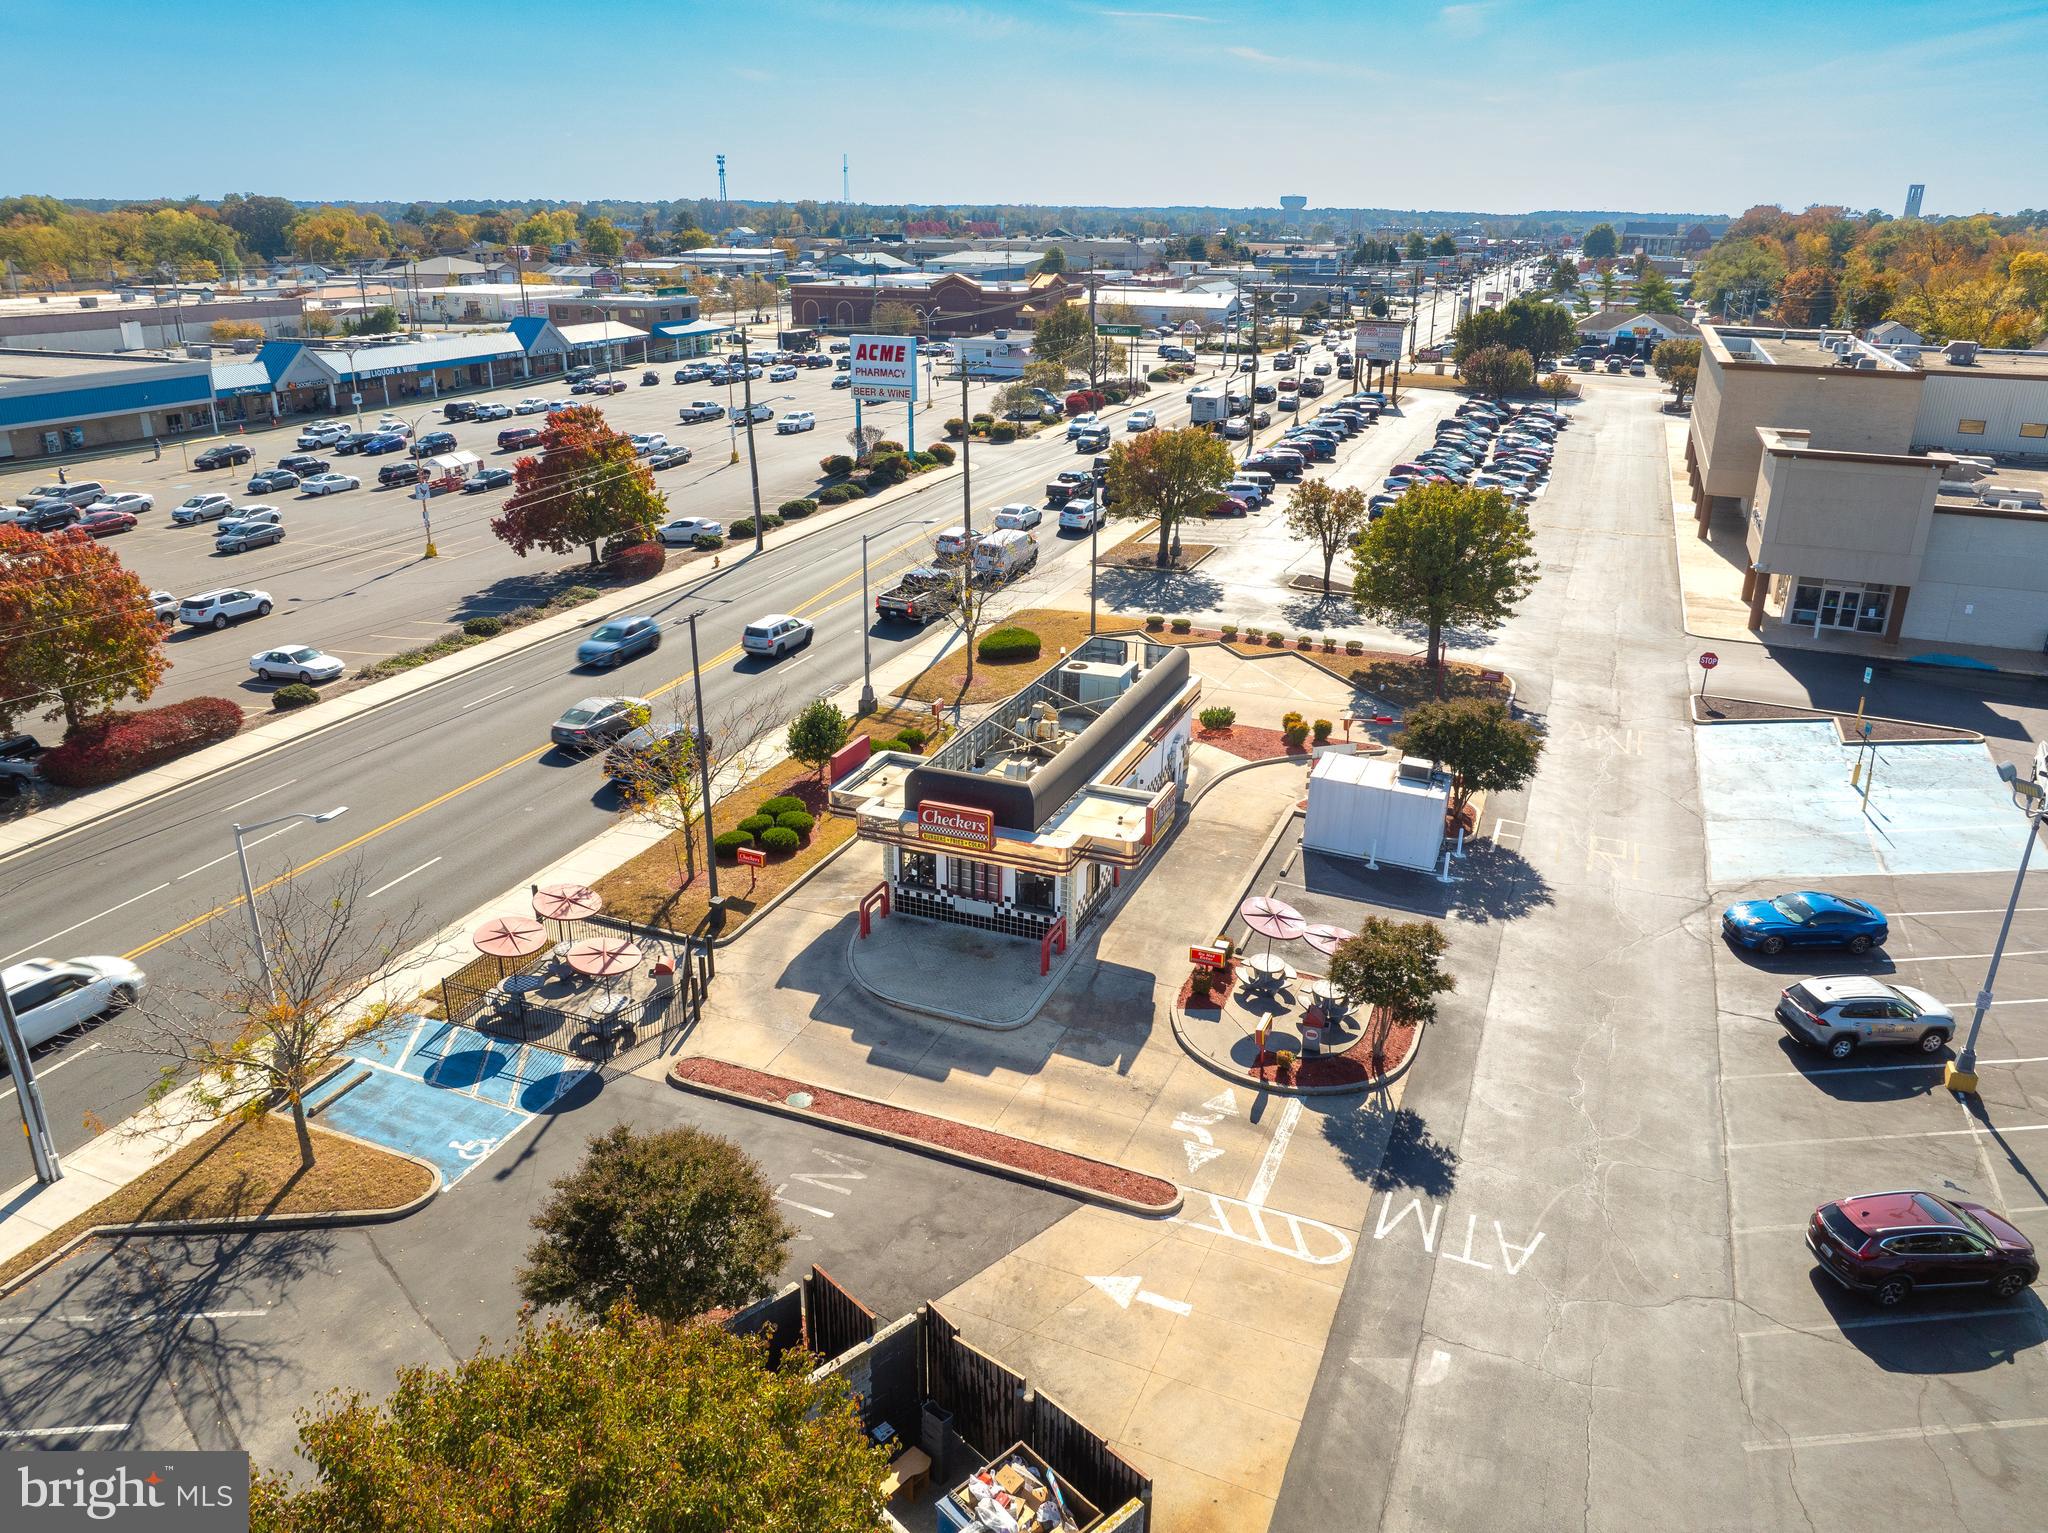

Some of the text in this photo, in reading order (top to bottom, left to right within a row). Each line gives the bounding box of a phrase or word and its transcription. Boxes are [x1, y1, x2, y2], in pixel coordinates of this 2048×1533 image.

[855, 343, 906, 362] ACME
[371, 368, 395, 377] LIQUOR
[396, 366, 401, 374] &
[403, 365, 418, 373] WINE
[855, 367, 906, 378] PHARMACY
[853, 387, 877, 397] BEER
[878, 388, 885, 397] &
[1700, 656, 1718, 665] STOP
[922, 809, 985, 832] Checkers
[1374, 1191, 1546, 1275] ATM
